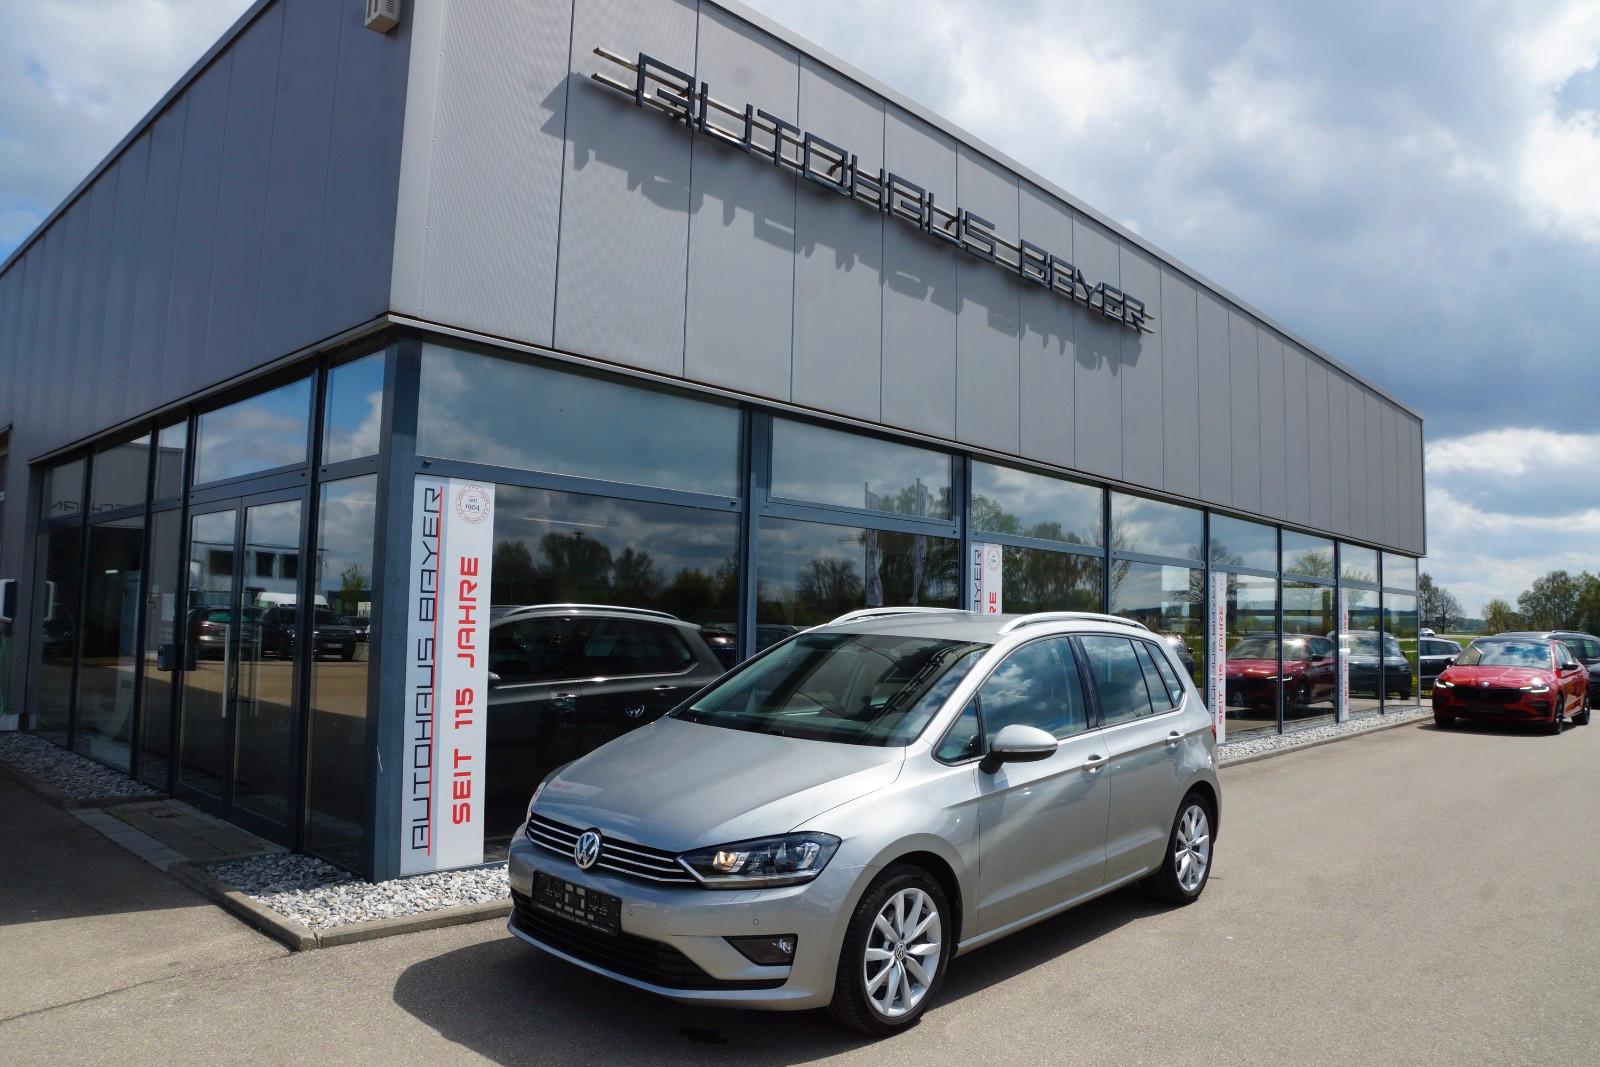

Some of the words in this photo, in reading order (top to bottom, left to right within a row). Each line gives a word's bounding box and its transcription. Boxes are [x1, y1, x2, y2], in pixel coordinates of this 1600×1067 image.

[636, 52, 996, 262] AUTOHAUS
[1019, 238, 1147, 333] BAYER
[419, 487, 441, 622] BAYER
[464, 503, 480, 512] 1904
[457, 556, 479, 668] JAHRE
[411, 637, 435, 851] AUTOHAUS
[455, 687, 474, 730] 115
[452, 748, 472, 825] SEIT
